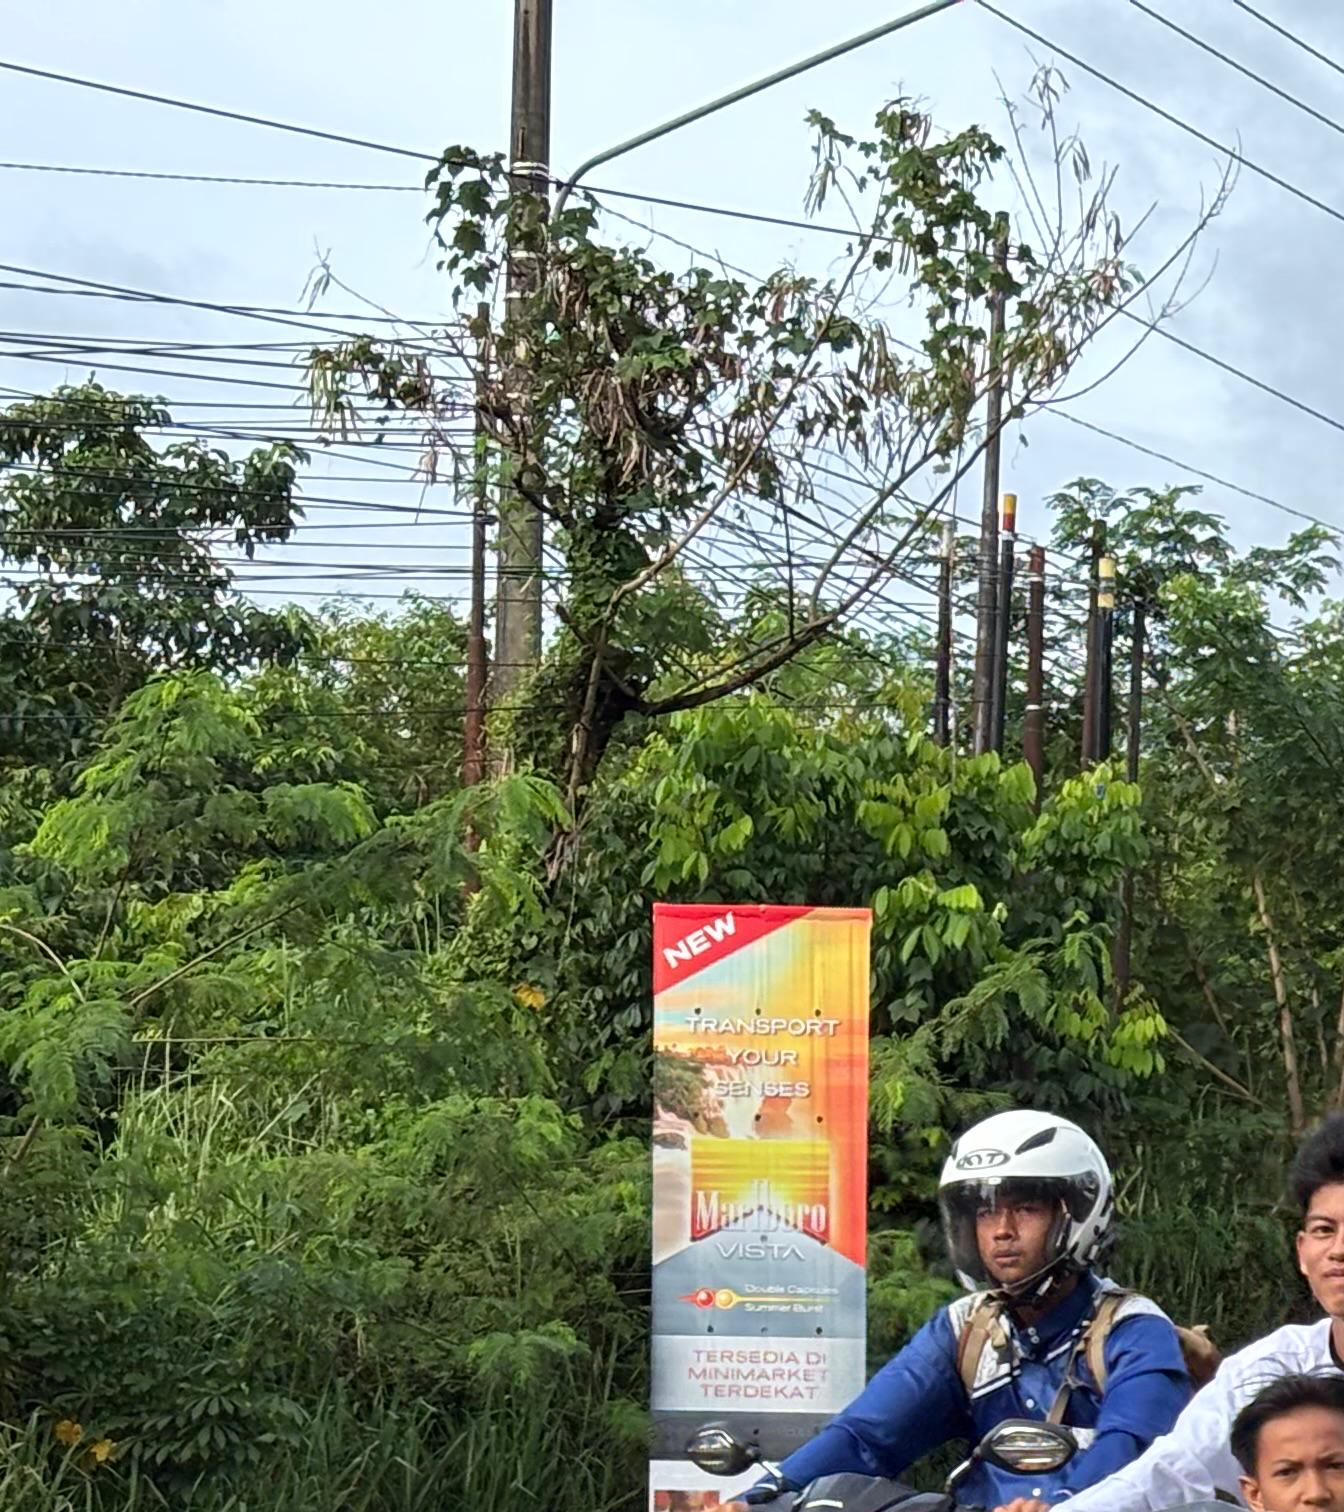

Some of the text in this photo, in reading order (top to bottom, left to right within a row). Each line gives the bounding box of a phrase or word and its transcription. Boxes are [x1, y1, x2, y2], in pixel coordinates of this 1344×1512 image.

[662, 911, 736, 969] NEW
[685, 1016, 840, 1036] TRANSPORT
[726, 1049, 798, 1066] YOUR
[714, 1081, 811, 1098] SENSES
[715, 1242, 806, 1260] VISTA
[693, 1350, 827, 1366] TERSEDIA DI
[687, 1367, 829, 1383] MINIMARKET
[700, 1383, 822, 1399] TERDEKAT
